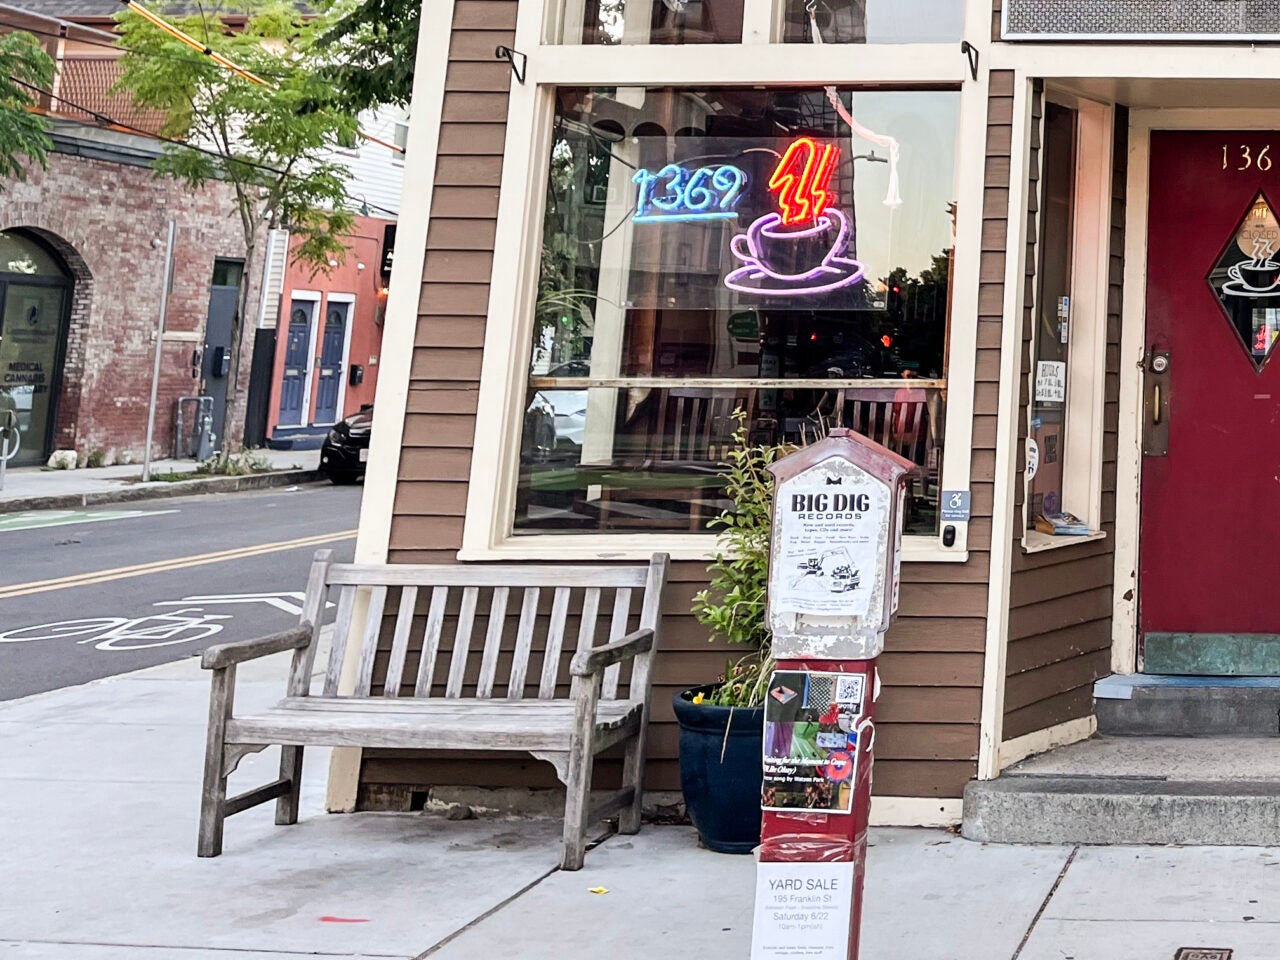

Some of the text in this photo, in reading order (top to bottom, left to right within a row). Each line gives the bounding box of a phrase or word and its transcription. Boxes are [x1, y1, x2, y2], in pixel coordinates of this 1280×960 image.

[631, 163, 742, 217] 1369
[1241, 230, 1279, 240] CLOSED
[9, 362, 43, 372] MEDICAL
[791, 493, 870, 512] BIG DIG
[769, 878, 839, 890] YARD SALE
[774, 894, 832, 903] 195 Franklin St
[773, 912, 829, 922] Saturday 6/22
